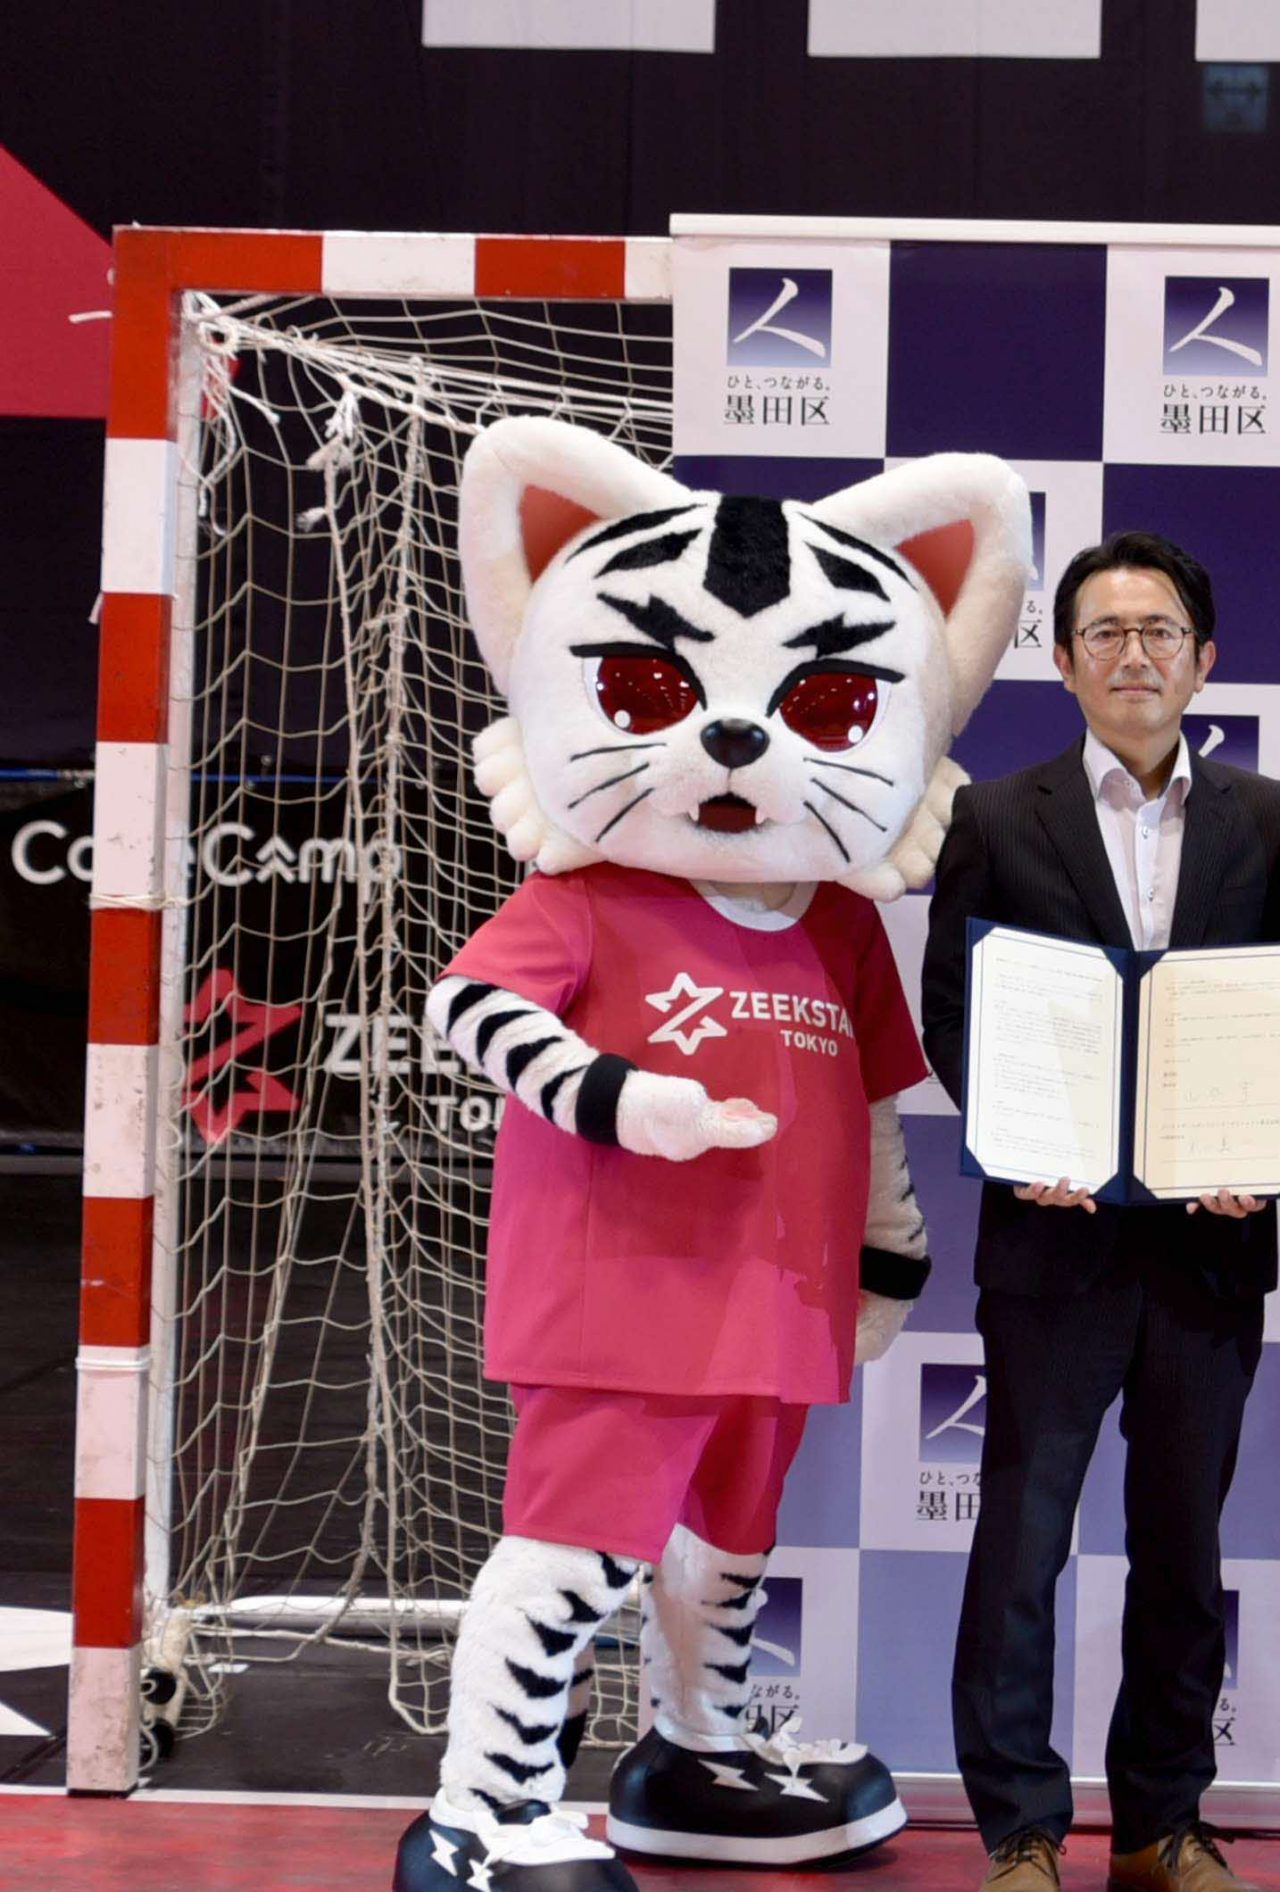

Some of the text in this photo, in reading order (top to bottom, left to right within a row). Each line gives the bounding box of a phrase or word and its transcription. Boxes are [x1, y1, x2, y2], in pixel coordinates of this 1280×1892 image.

[725, 394, 828, 426] 墨田区
[1161, 403, 1266, 435] 墨田区
[729, 991, 855, 1039] ZEEKSTA
[780, 1029, 839, 1057] TOKYO
